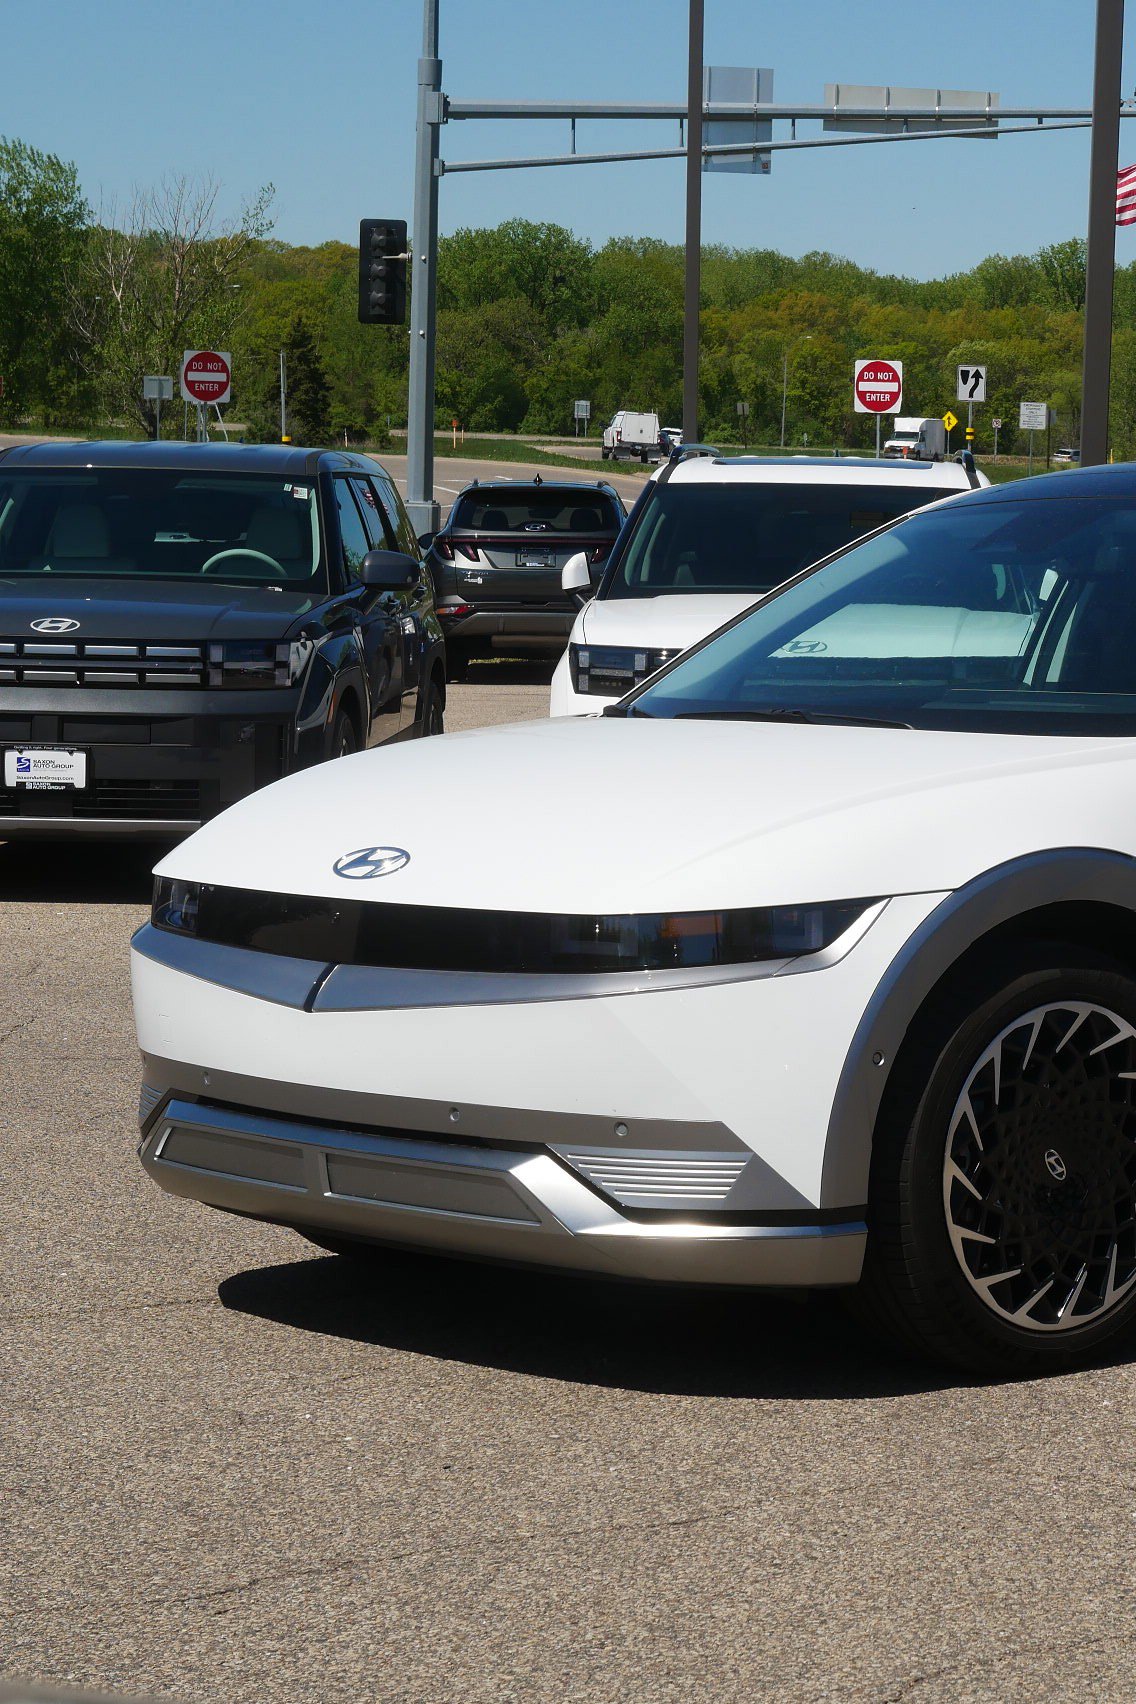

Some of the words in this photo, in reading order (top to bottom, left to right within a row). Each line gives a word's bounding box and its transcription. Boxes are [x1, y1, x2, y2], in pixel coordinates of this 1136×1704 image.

[192, 362, 203, 370] DO
[207, 362, 222, 371] NOT
[863, 371, 875, 380] DO
[877, 372, 894, 380] NOT
[194, 383, 219, 391] ENTER
[865, 393, 891, 402] ENTER
